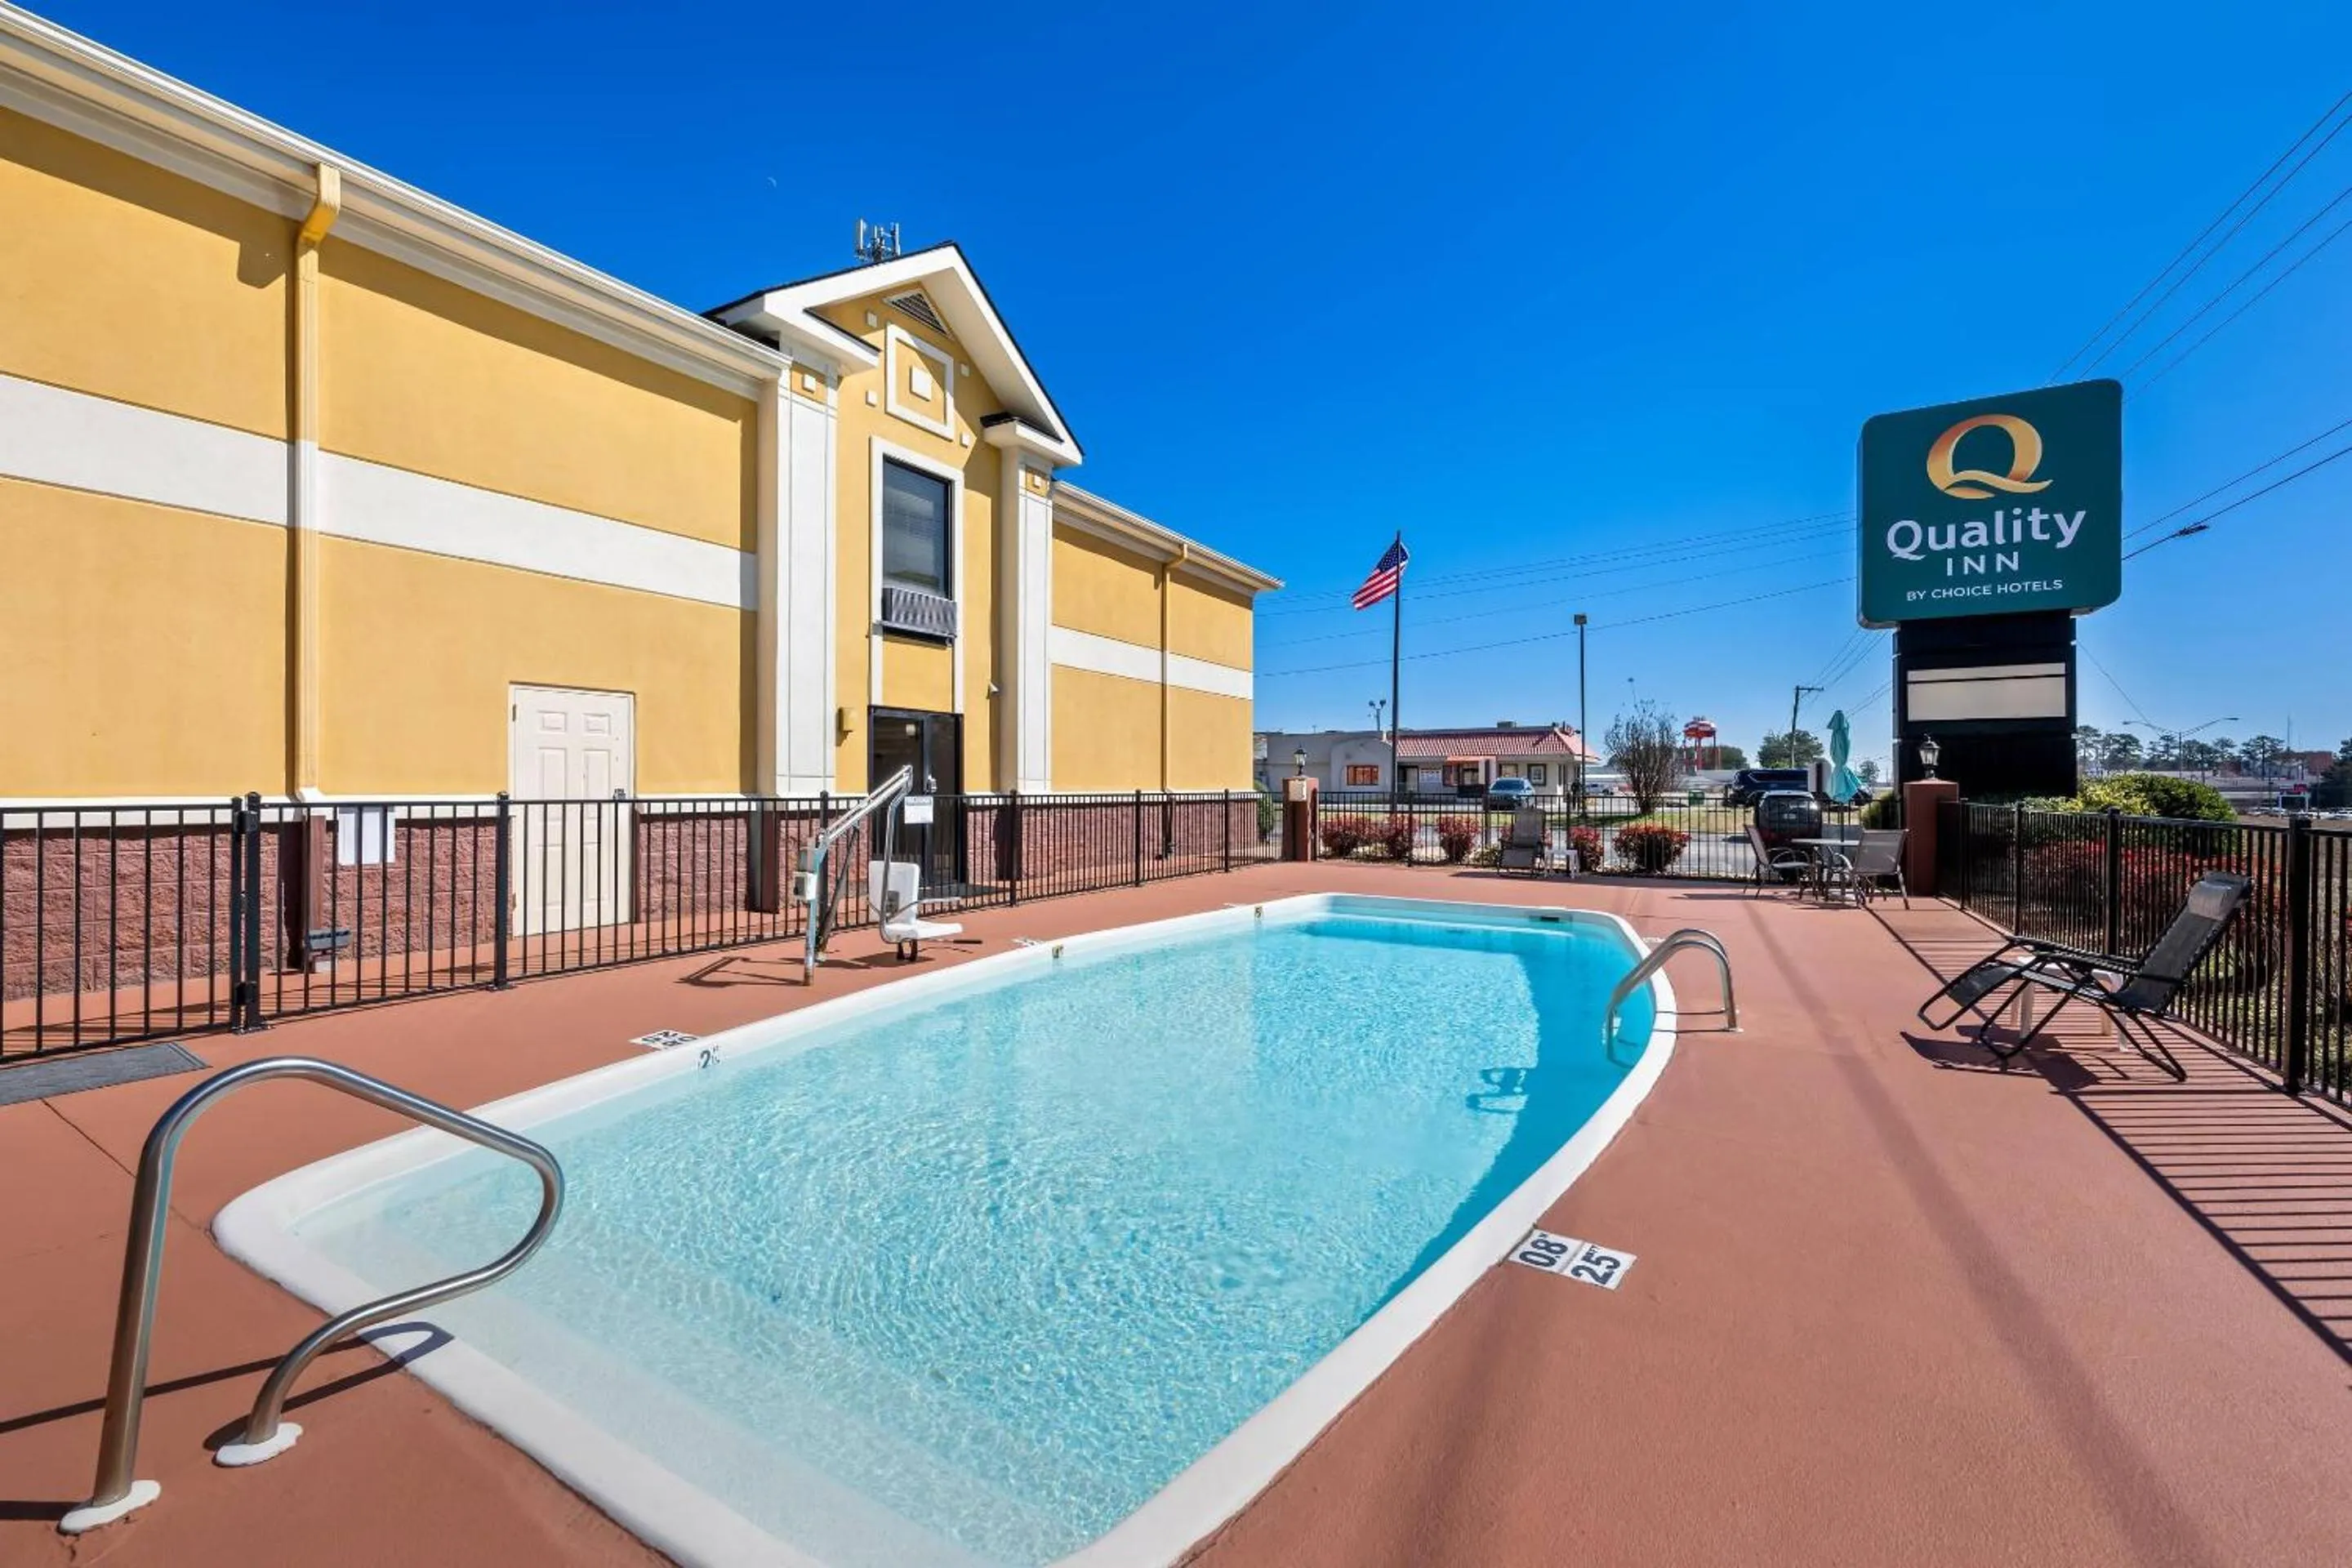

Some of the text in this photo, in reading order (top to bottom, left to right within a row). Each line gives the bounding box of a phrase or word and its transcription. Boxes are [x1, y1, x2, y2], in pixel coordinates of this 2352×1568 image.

[1927, 414, 2053, 499] Q
[1886, 508, 2087, 560] Quality
[1947, 552, 2019, 576] INN
[1907, 579, 2064, 602] BY CHOICE HOTELS
